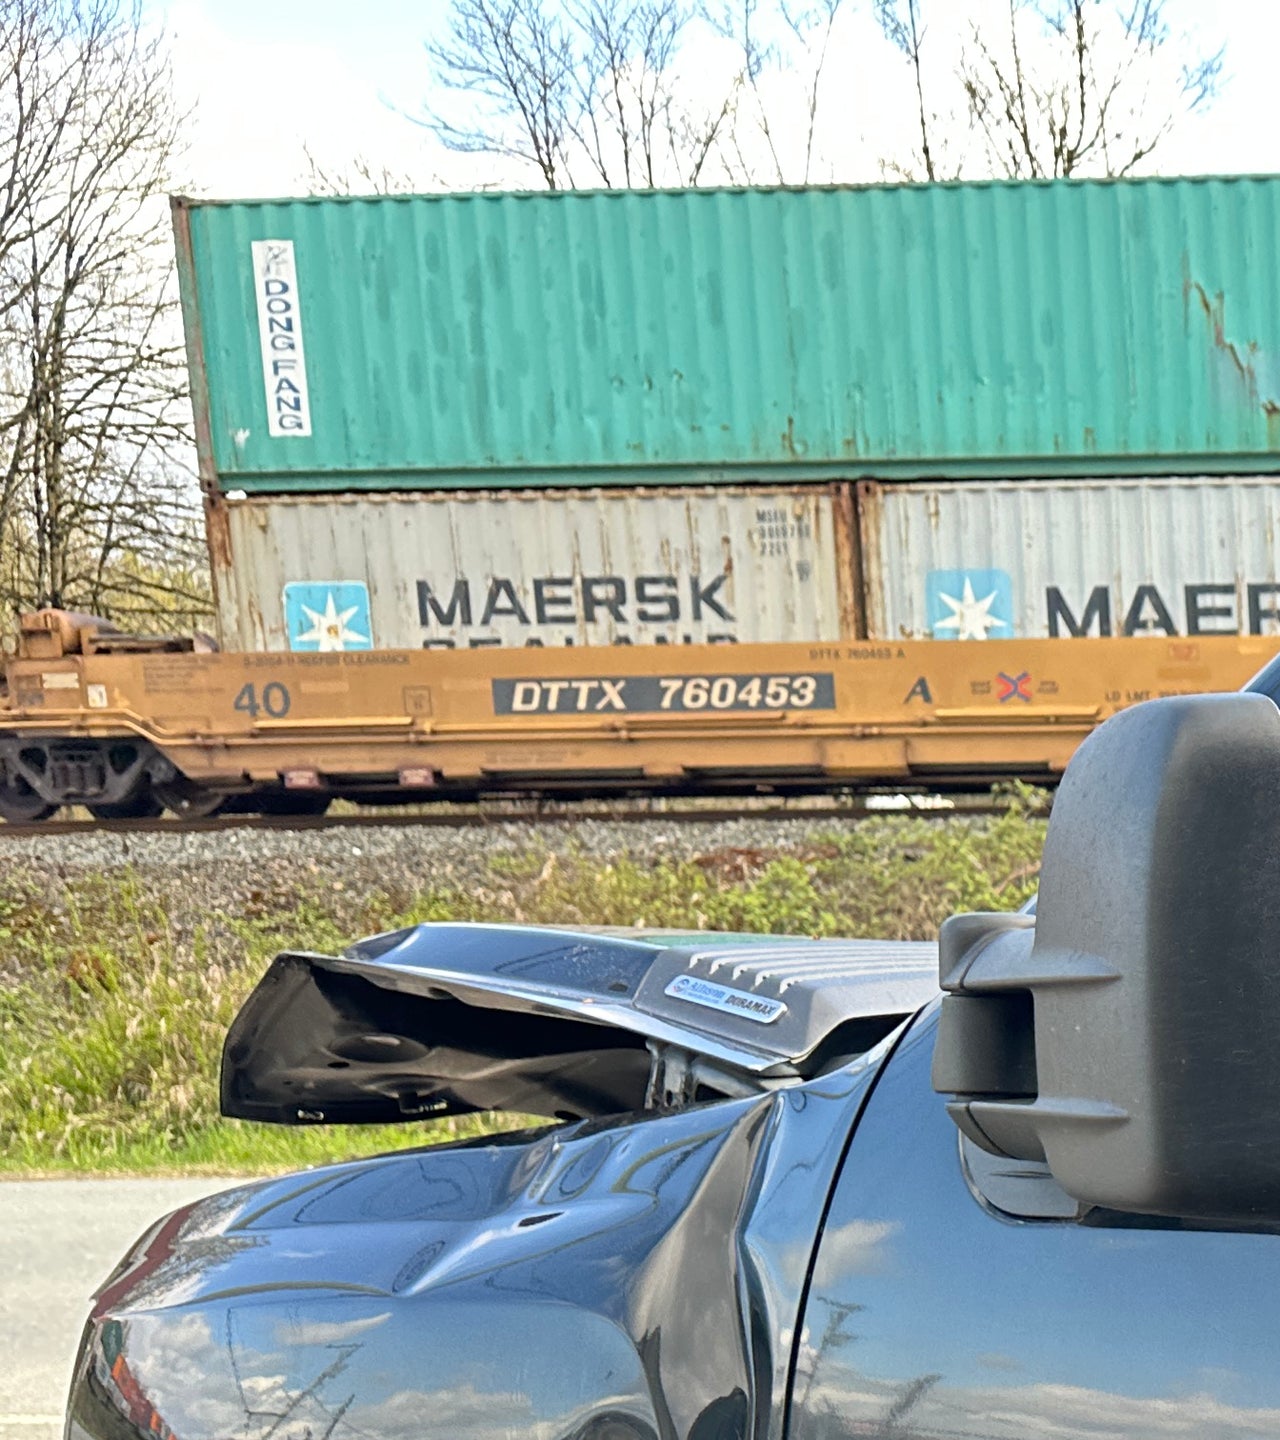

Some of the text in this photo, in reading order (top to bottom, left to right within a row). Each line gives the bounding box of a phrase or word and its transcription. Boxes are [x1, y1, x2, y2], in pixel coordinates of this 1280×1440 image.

[264, 279, 304, 430] DONG FANG
[416, 574, 736, 627] MAERSK
[233, 681, 291, 718] 40
[512, 675, 817, 712] DTTX 760453
[904, 676, 933, 704] A
